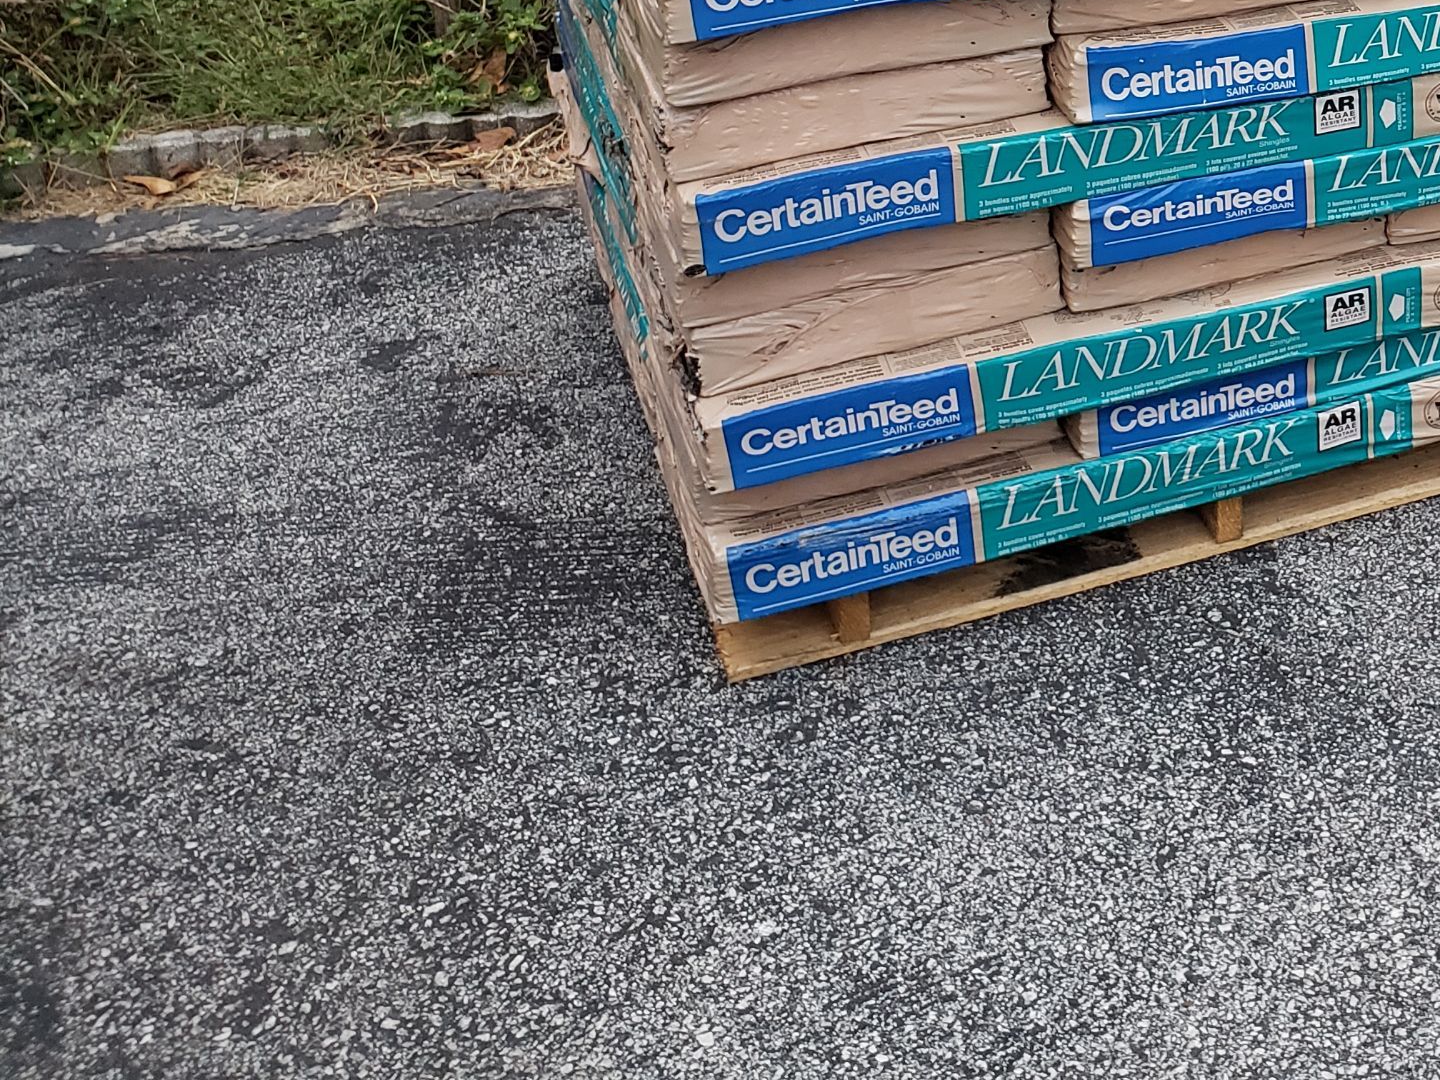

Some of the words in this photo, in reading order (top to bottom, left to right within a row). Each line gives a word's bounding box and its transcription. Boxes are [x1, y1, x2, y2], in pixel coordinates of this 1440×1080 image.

[1101, 48, 1295, 101] CertainTeed
[1226, 79, 1296, 98] SAINT-GOBAIN
[1320, 111, 1355, 122] ALGAE
[1321, 96, 1355, 114] AR
[1320, 117, 1357, 127] RESISTANT
[978, 98, 1298, 188] LANDMARK
[713, 169, 938, 243] CertainTeed
[859, 201, 940, 226] SAINT-GOBAIN
[1103, 179, 1294, 231] CertainTeed
[1225, 200, 1294, 220] SAINT-GOBAIN
[1331, 290, 1365, 310] AR
[1330, 306, 1366, 319] ALGAE
[1330, 312, 1367, 324] RESISTANT
[997, 299, 1309, 401] LANDMARK
[1109, 373, 1295, 433] CertainTeed
[1227, 398, 1295, 420] SAINT-GOBAIN
[740, 387, 959, 456] CertainTeed
[882, 413, 961, 437] SAINT-GOBAIN
[1324, 407, 1356, 429] AR
[1324, 421, 1357, 437] ALGAE
[996, 417, 1299, 530] LANDMARK
[745, 517, 959, 594] CertainTeed
[883, 546, 960, 574] SAINT-GOBAIN
